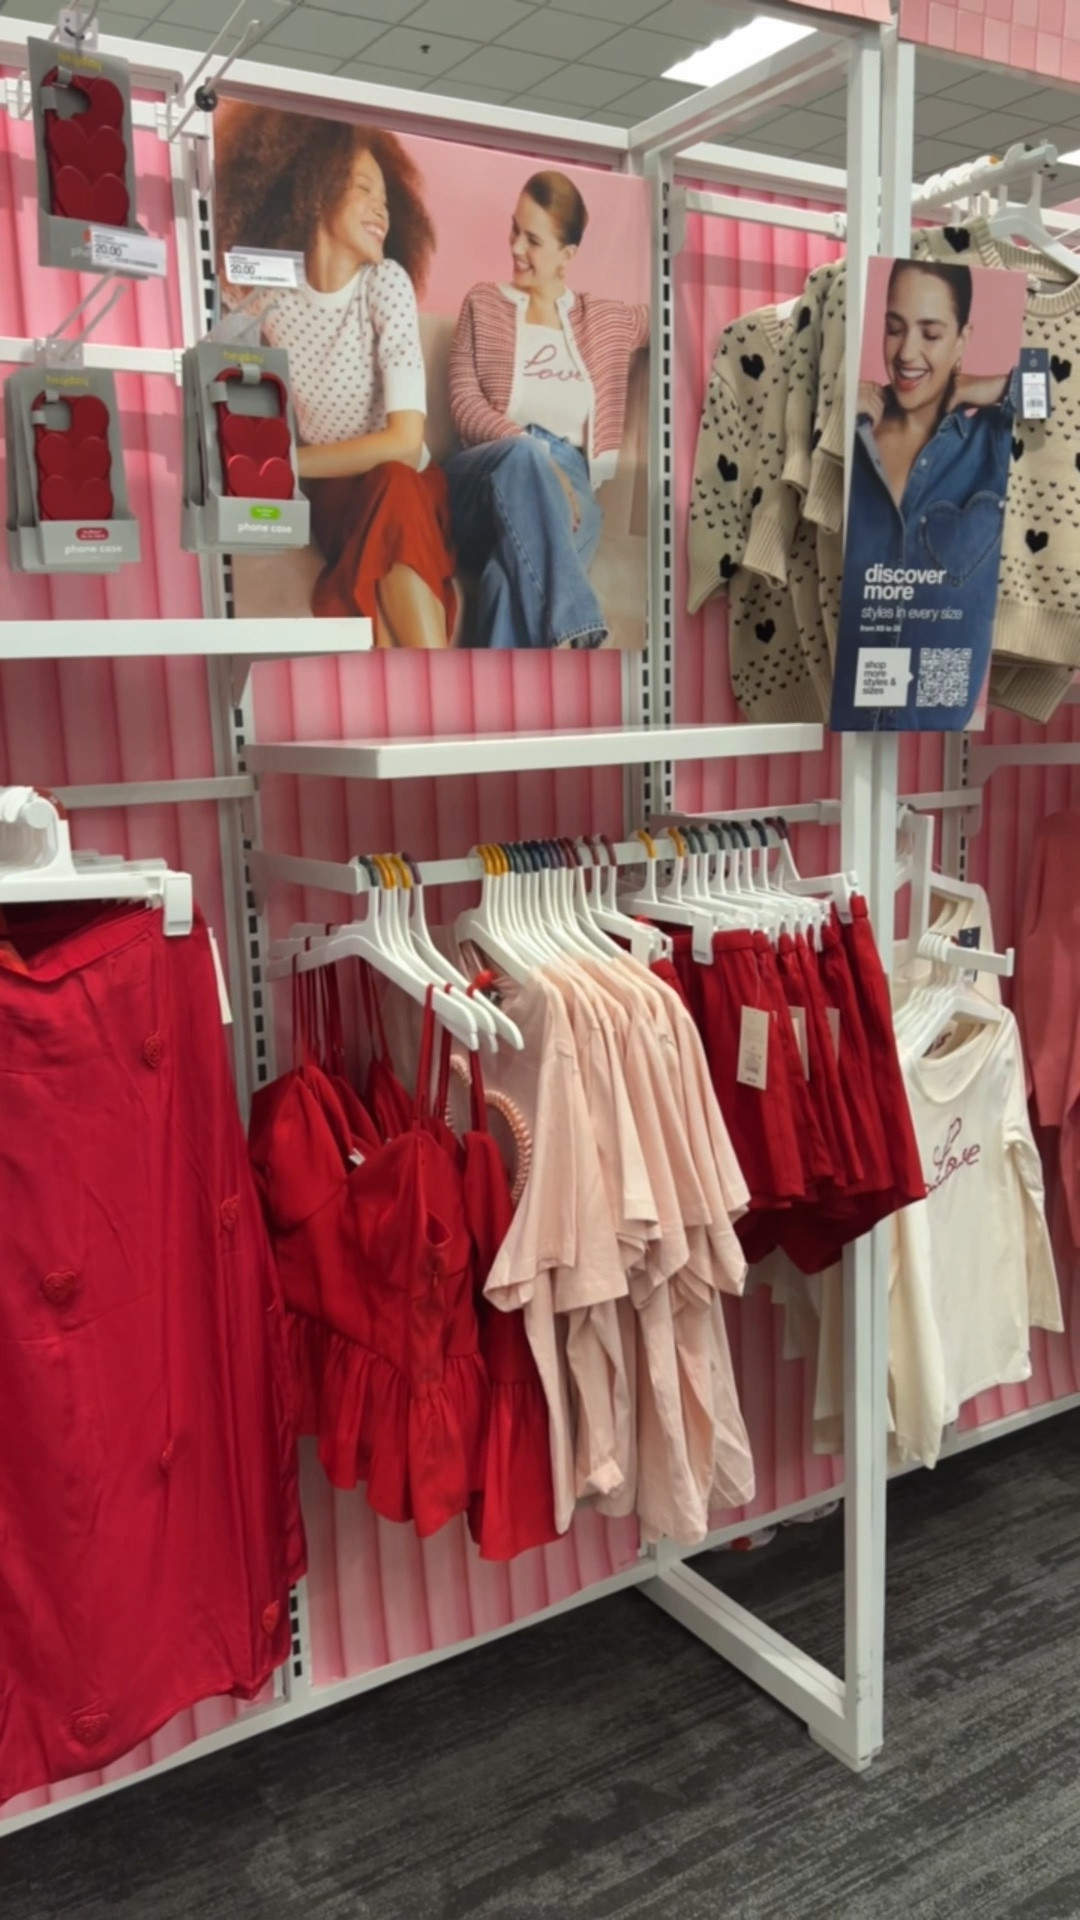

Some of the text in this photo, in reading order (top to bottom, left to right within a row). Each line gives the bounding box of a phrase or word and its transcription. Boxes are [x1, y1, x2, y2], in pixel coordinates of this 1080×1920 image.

[95, 244, 123, 257] 20.00
[230, 263, 256, 276] 20.00
[237, 522, 293, 534] phone case
[65, 543, 122, 556] phone case
[865, 563, 947, 584] discover
[863, 584, 915, 600] more
[861, 605, 963, 622] styles in every size
[864, 660, 887, 670] shop
[863, 670, 887, 678] more
[863, 677, 897, 687] styles &
[862, 687, 885, 695] sizes
